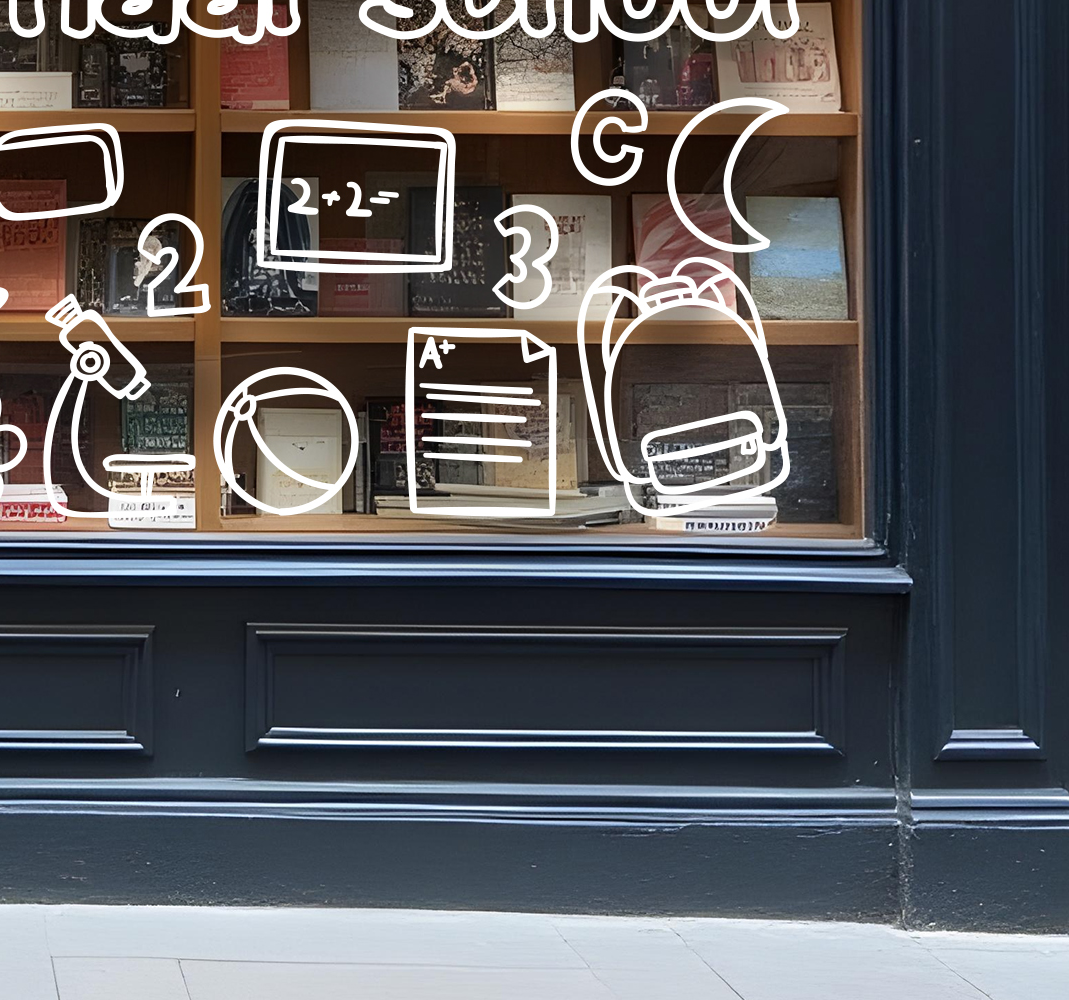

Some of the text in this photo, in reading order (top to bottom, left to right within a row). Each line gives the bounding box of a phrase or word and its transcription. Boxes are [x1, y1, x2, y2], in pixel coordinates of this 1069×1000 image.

[571, 89, 649, 187] C
[138, 213, 211, 318] 2
[492, 204, 559, 310] 3
[419, 336, 456, 370] A+
